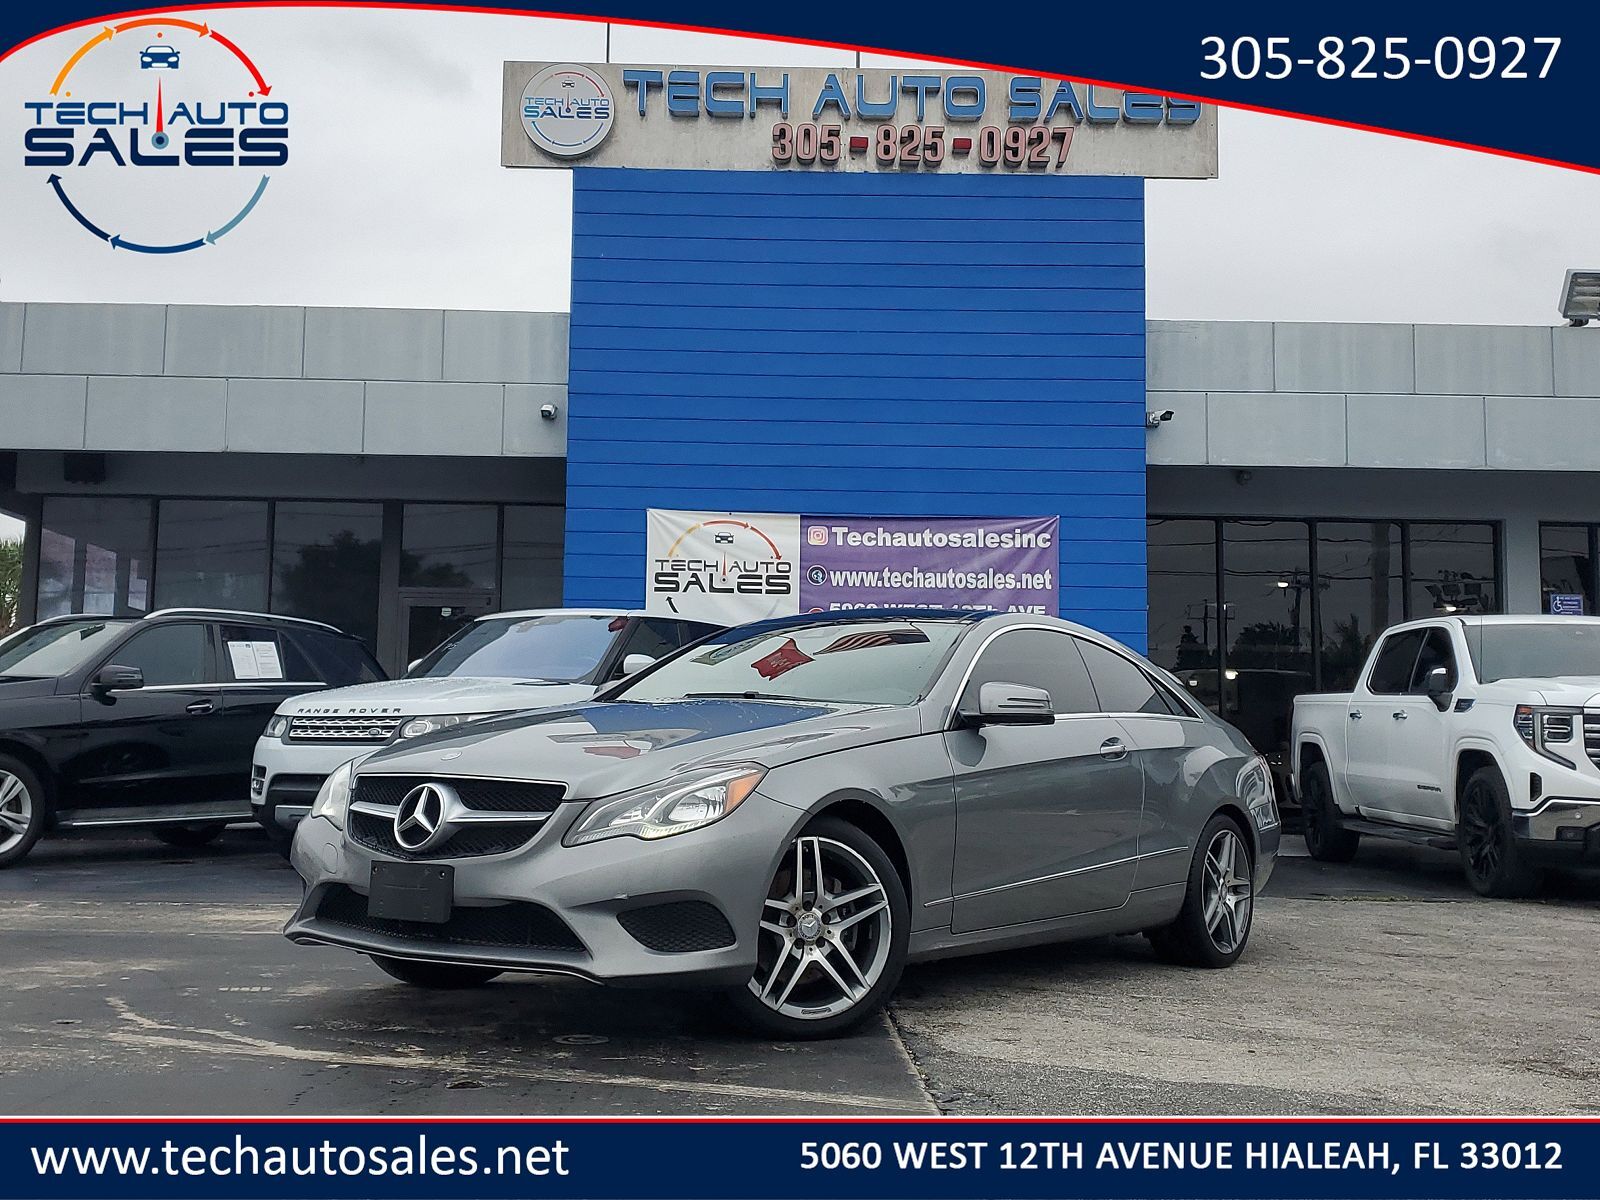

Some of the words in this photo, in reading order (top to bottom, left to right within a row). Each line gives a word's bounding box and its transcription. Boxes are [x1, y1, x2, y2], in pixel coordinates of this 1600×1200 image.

[525, 97, 564, 106] TECH
[570, 98, 609, 106] AUTO
[623, 69, 789, 119] TECH
[812, 72, 988, 122] AUTO
[1008, 76, 1202, 125] SALES
[524, 105, 609, 119] SALES
[831, 526, 1052, 548] Techautosalesinc
[655, 559, 719, 572] TECH
[728, 561, 792, 574] AUTO
[653, 572, 791, 595] SALES
[830, 567, 1052, 590] www.techautosales.net
